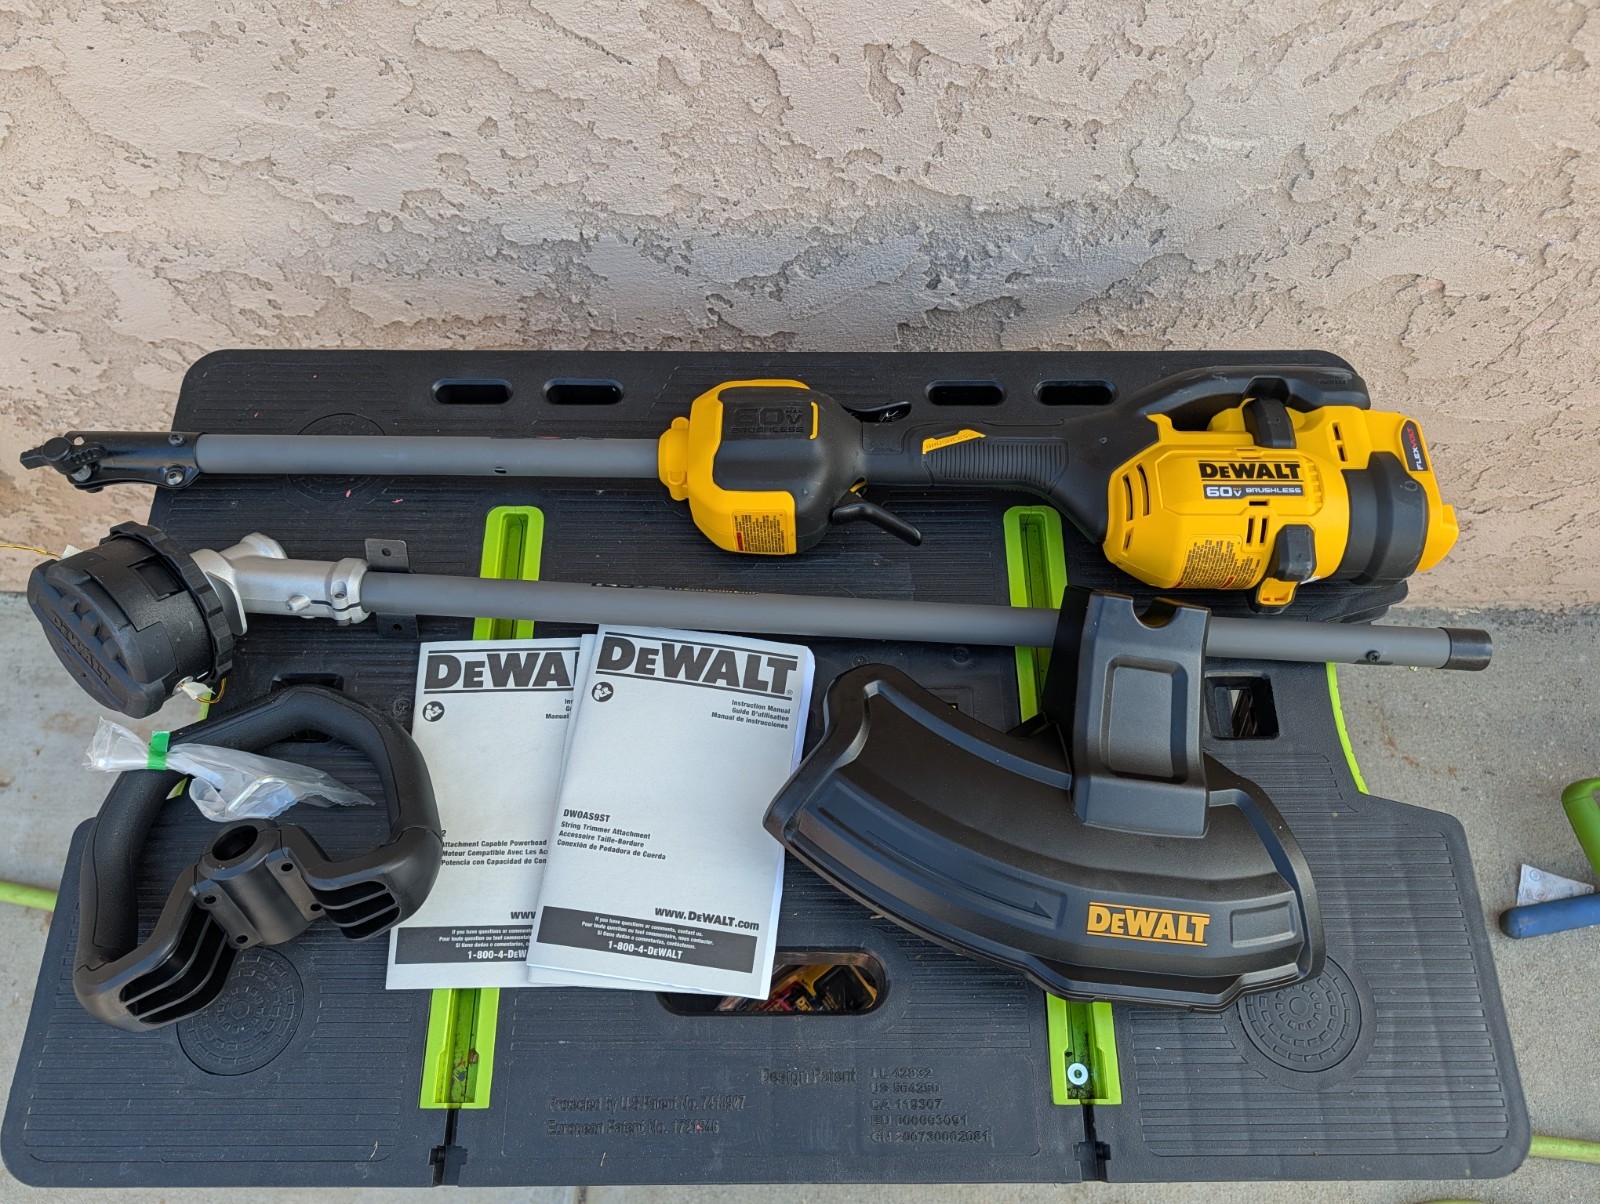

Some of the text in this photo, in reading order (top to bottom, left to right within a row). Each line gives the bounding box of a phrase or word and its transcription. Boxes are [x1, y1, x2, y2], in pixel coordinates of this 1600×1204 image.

[1406, 426, 1424, 470] FLEXVOLT
[732, 700, 790, 714] Instruction Manual
[712, 712, 734, 720] Manual
[746, 718, 788, 729] instrucciones
[559, 830, 644, 847] Accessoire Taille-Bordure
[561, 821, 650, 839] String Trimmer Attachment
[468, 849, 505, 857] Compatible
[557, 839, 587, 848] Conexión
[599, 844, 630, 855] Podadora
[642, 850, 666, 860] Cuerda
[487, 858, 521, 866] Capacidad
[621, 919, 644, 928] questions
[760, 1068, 857, 1088] Design Patent
[549, 1096, 600, 1112] Protected
[605, 1096, 617, 1115] by
[642, 1096, 679, 1111] Patent
[680, 1095, 699, 1111] No.
[548, 1120, 606, 1137] European
[607, 1120, 646, 1136] Patent
[650, 1120, 669, 1135] No.
